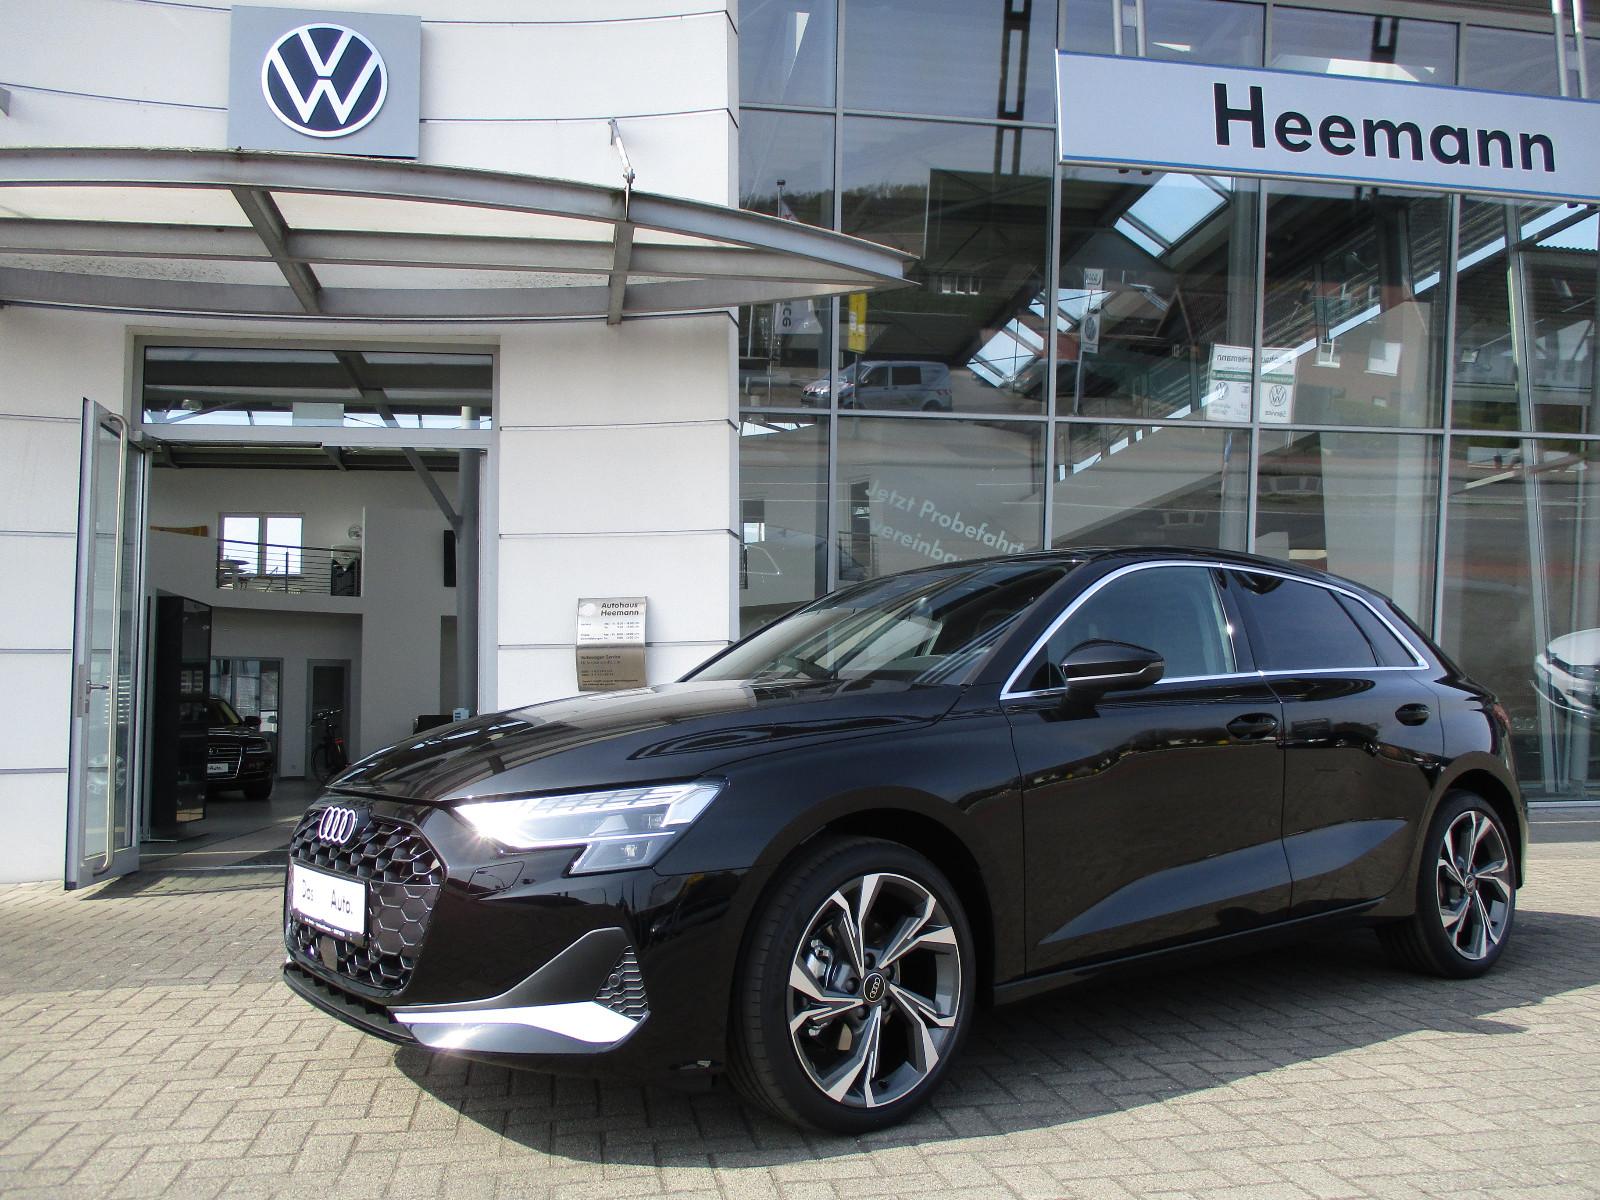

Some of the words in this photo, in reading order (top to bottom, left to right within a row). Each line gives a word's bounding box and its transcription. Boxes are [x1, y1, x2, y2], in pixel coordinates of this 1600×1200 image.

[1213, 83, 1556, 172] Heemann
[865, 480, 916, 512] Jetzt
[918, 499, 1026, 555] Probefahrt
[868, 520, 964, 563] vereinba
